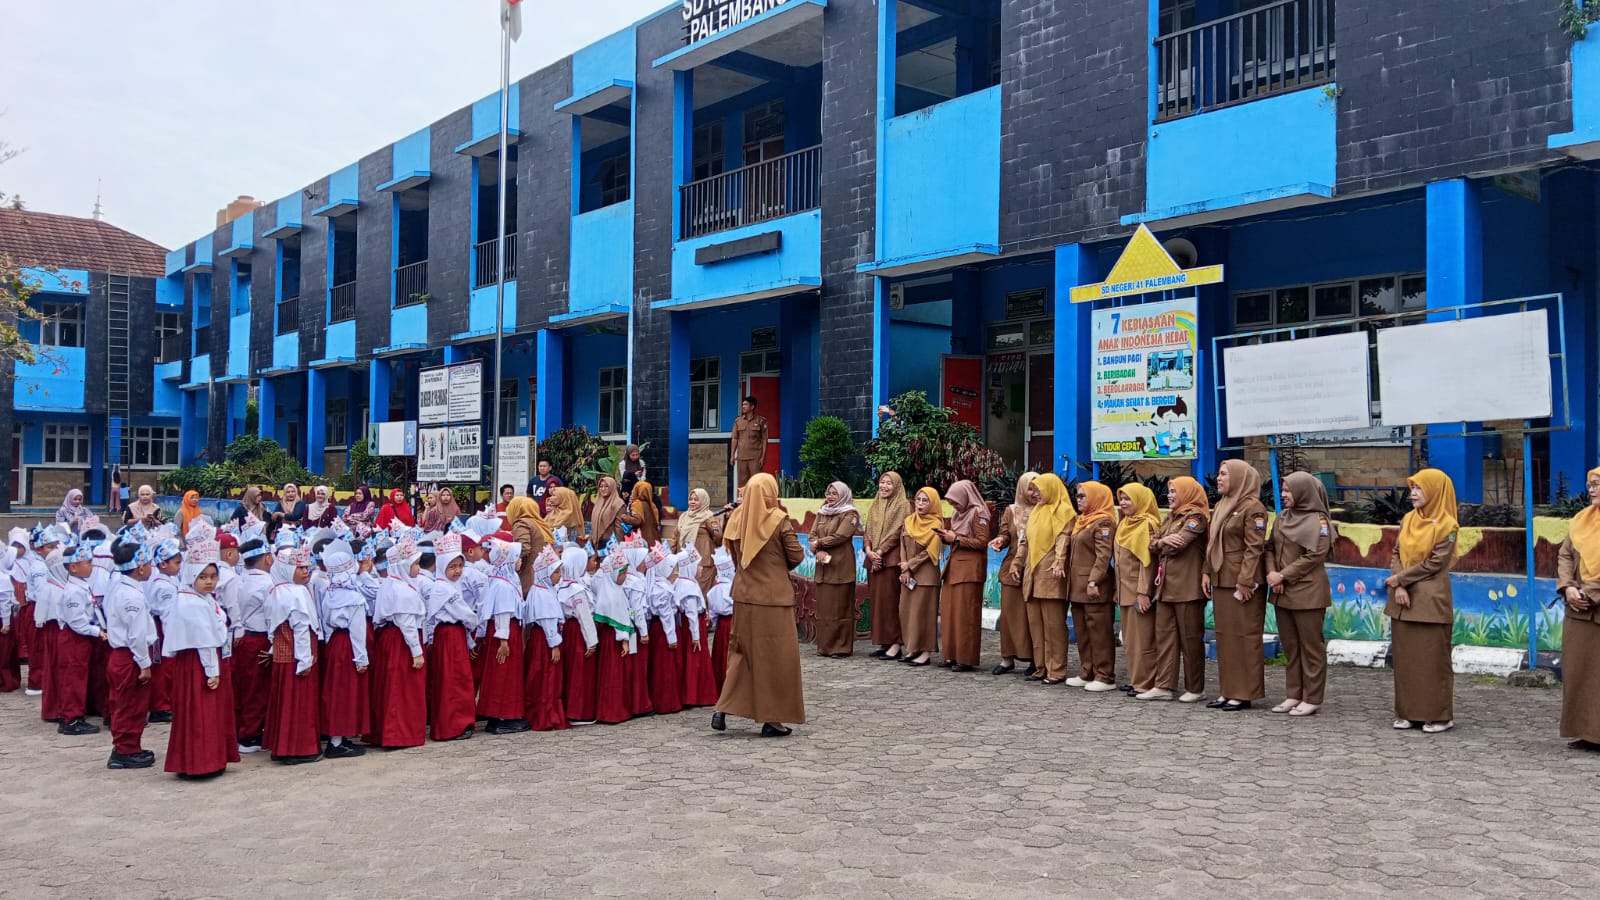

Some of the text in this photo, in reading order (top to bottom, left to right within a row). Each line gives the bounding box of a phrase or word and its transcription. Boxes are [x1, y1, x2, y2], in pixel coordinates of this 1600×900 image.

[1101, 286, 1110, 294] SD
[1136, 281, 1143, 289] 41
[1145, 274, 1186, 289] PALEMBANG
[1111, 313, 1175, 335] 7 KEBIASAAN
[1098, 330, 1188, 350] ANAK INDONESIA HEBAT
[1103, 354, 1126, 365] BANGUN
[1127, 353, 1142, 364] PAGI
[1097, 371, 1103, 380] 2.
[1097, 385, 1103, 394] 3.
[1103, 398, 1124, 408] MAKAN
[1125, 397, 1143, 407] SEHAT
[1144, 397, 1150, 406] &
[1152, 395, 1176, 406] BERGIZI
[461, 433, 477, 445] UKS
[1103, 441, 1121, 452] TIDUR
[1121, 441, 1141, 452] CEPAT
